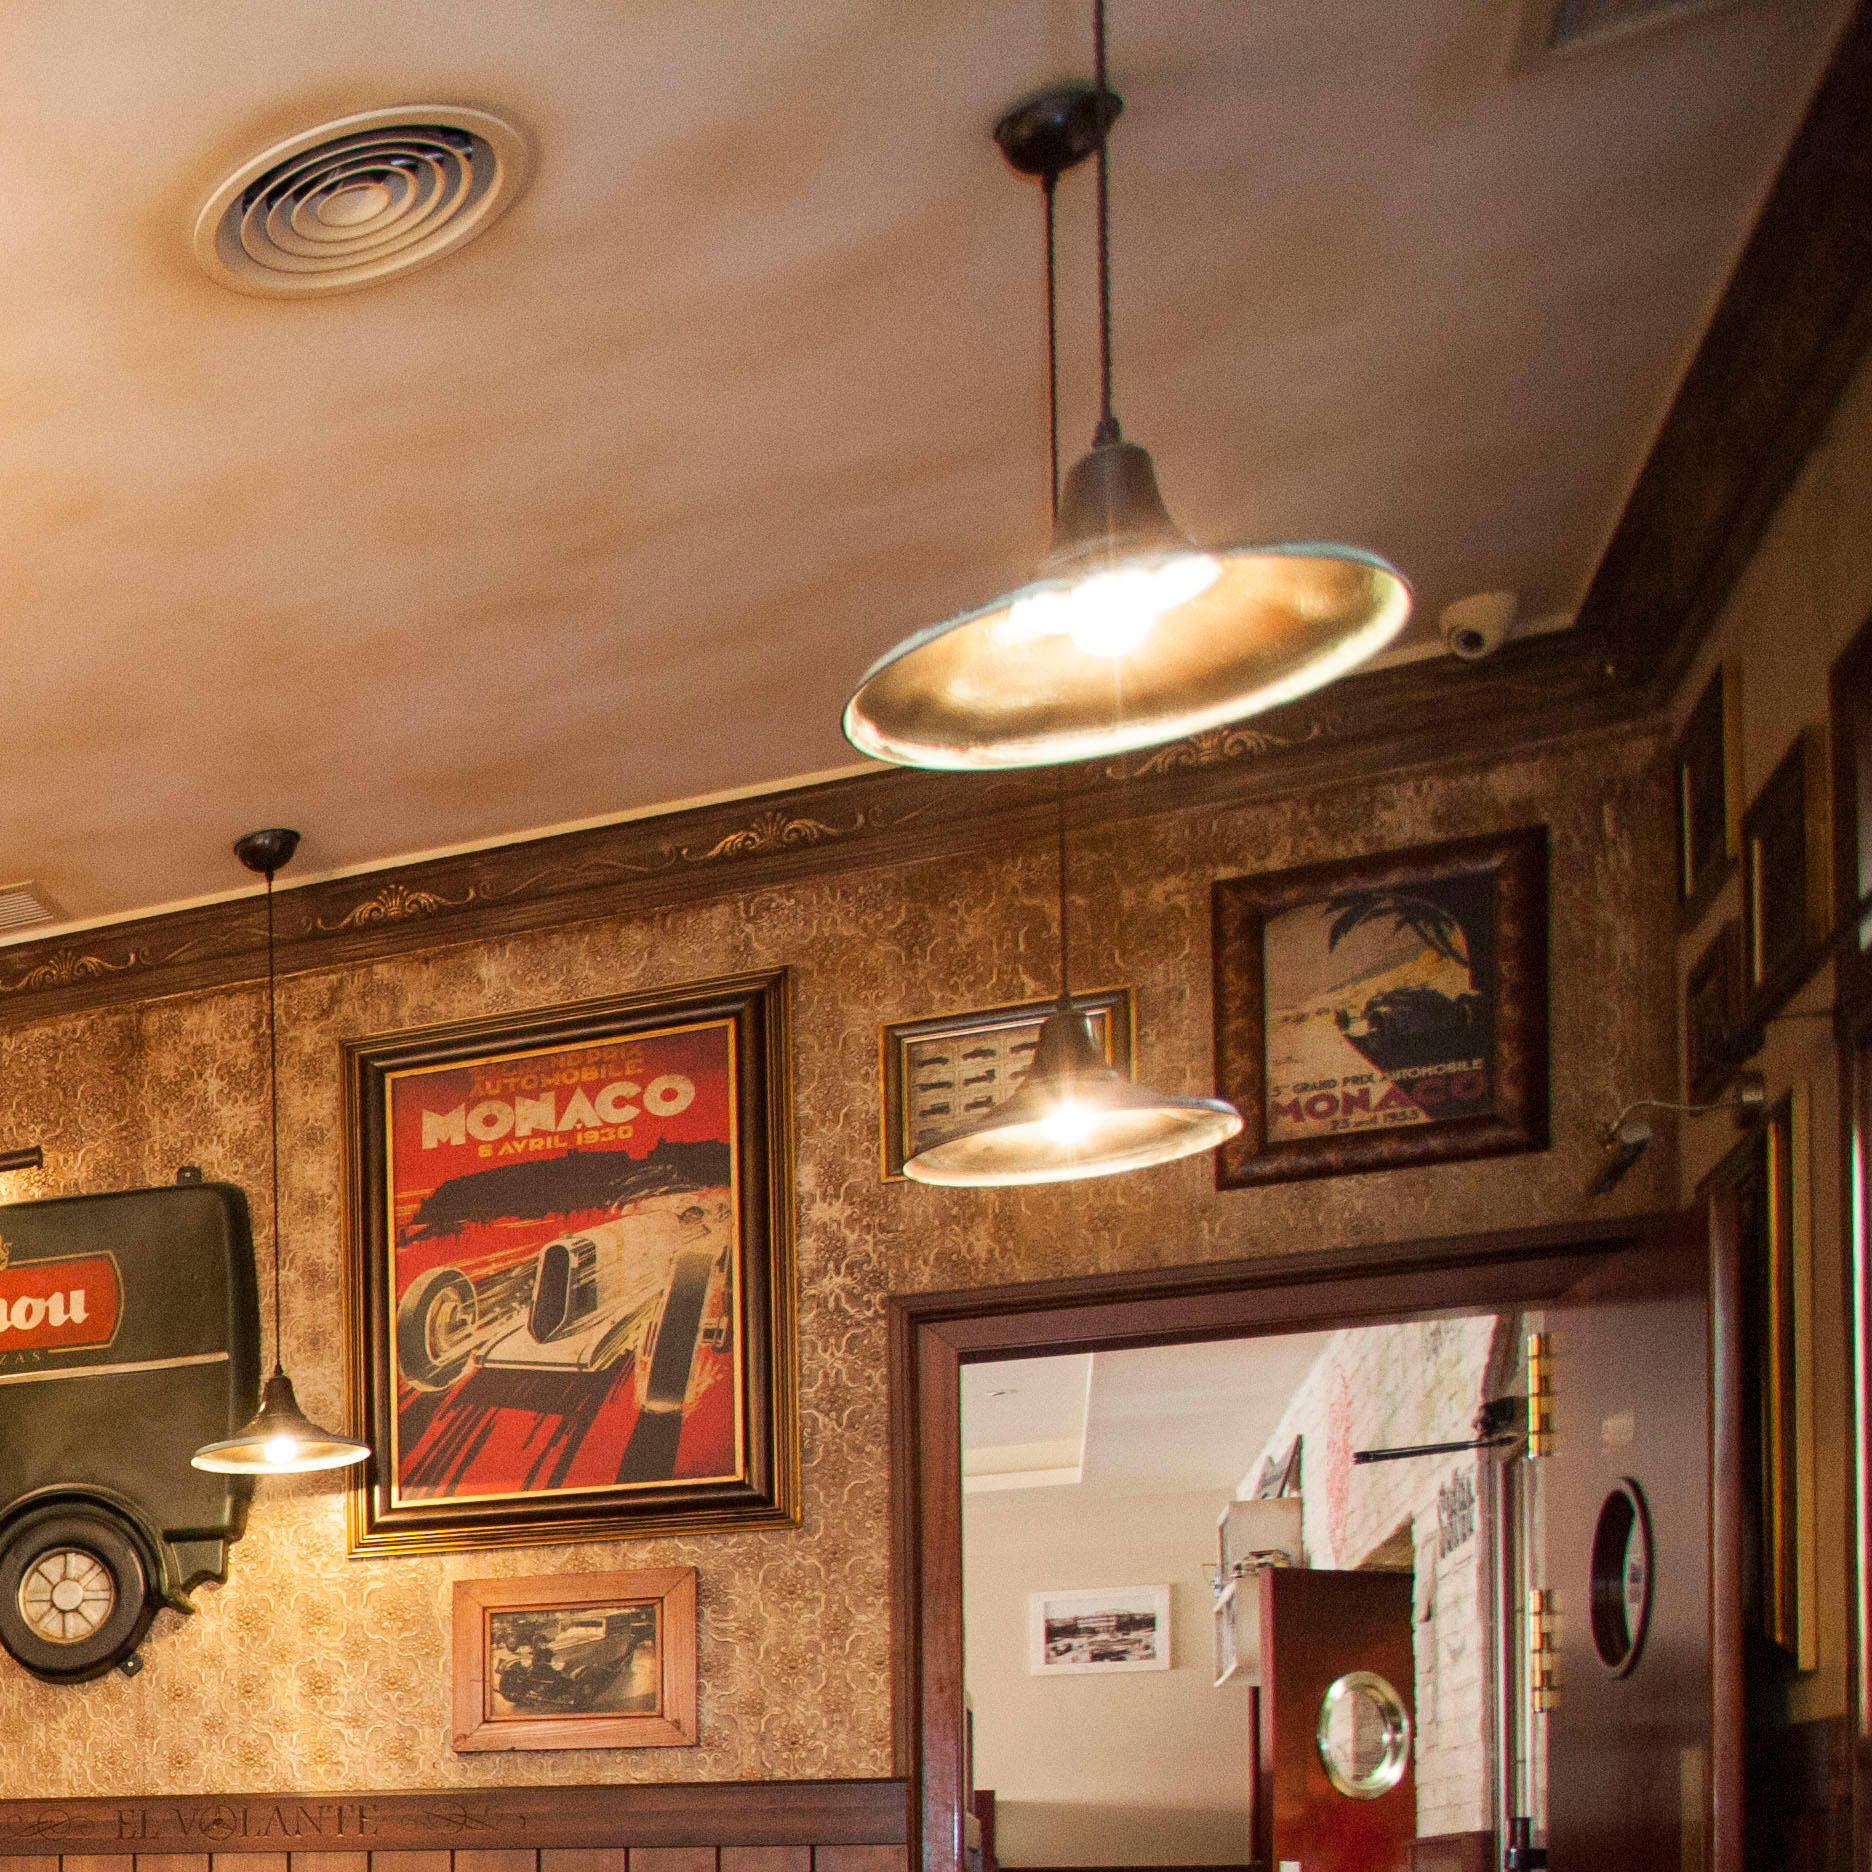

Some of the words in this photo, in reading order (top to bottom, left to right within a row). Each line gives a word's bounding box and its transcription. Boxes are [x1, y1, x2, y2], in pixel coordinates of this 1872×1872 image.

[470, 1059, 645, 1098] AUTOMOBILE
[1293, 1079, 1339, 1095] GRAND
[1342, 1072, 1376, 1087] PRIX
[1381, 1057, 1486, 1083] AUTOMOBILE
[421, 1074, 696, 1149] MONACO
[1267, 1071, 1487, 1124] MONACO
[498, 1132, 569, 1157] AVRIL
[577, 1126, 634, 1146] 1930
[114, 1807, 161, 1842] EL
[174, 1802, 381, 1841] VOLANTE
